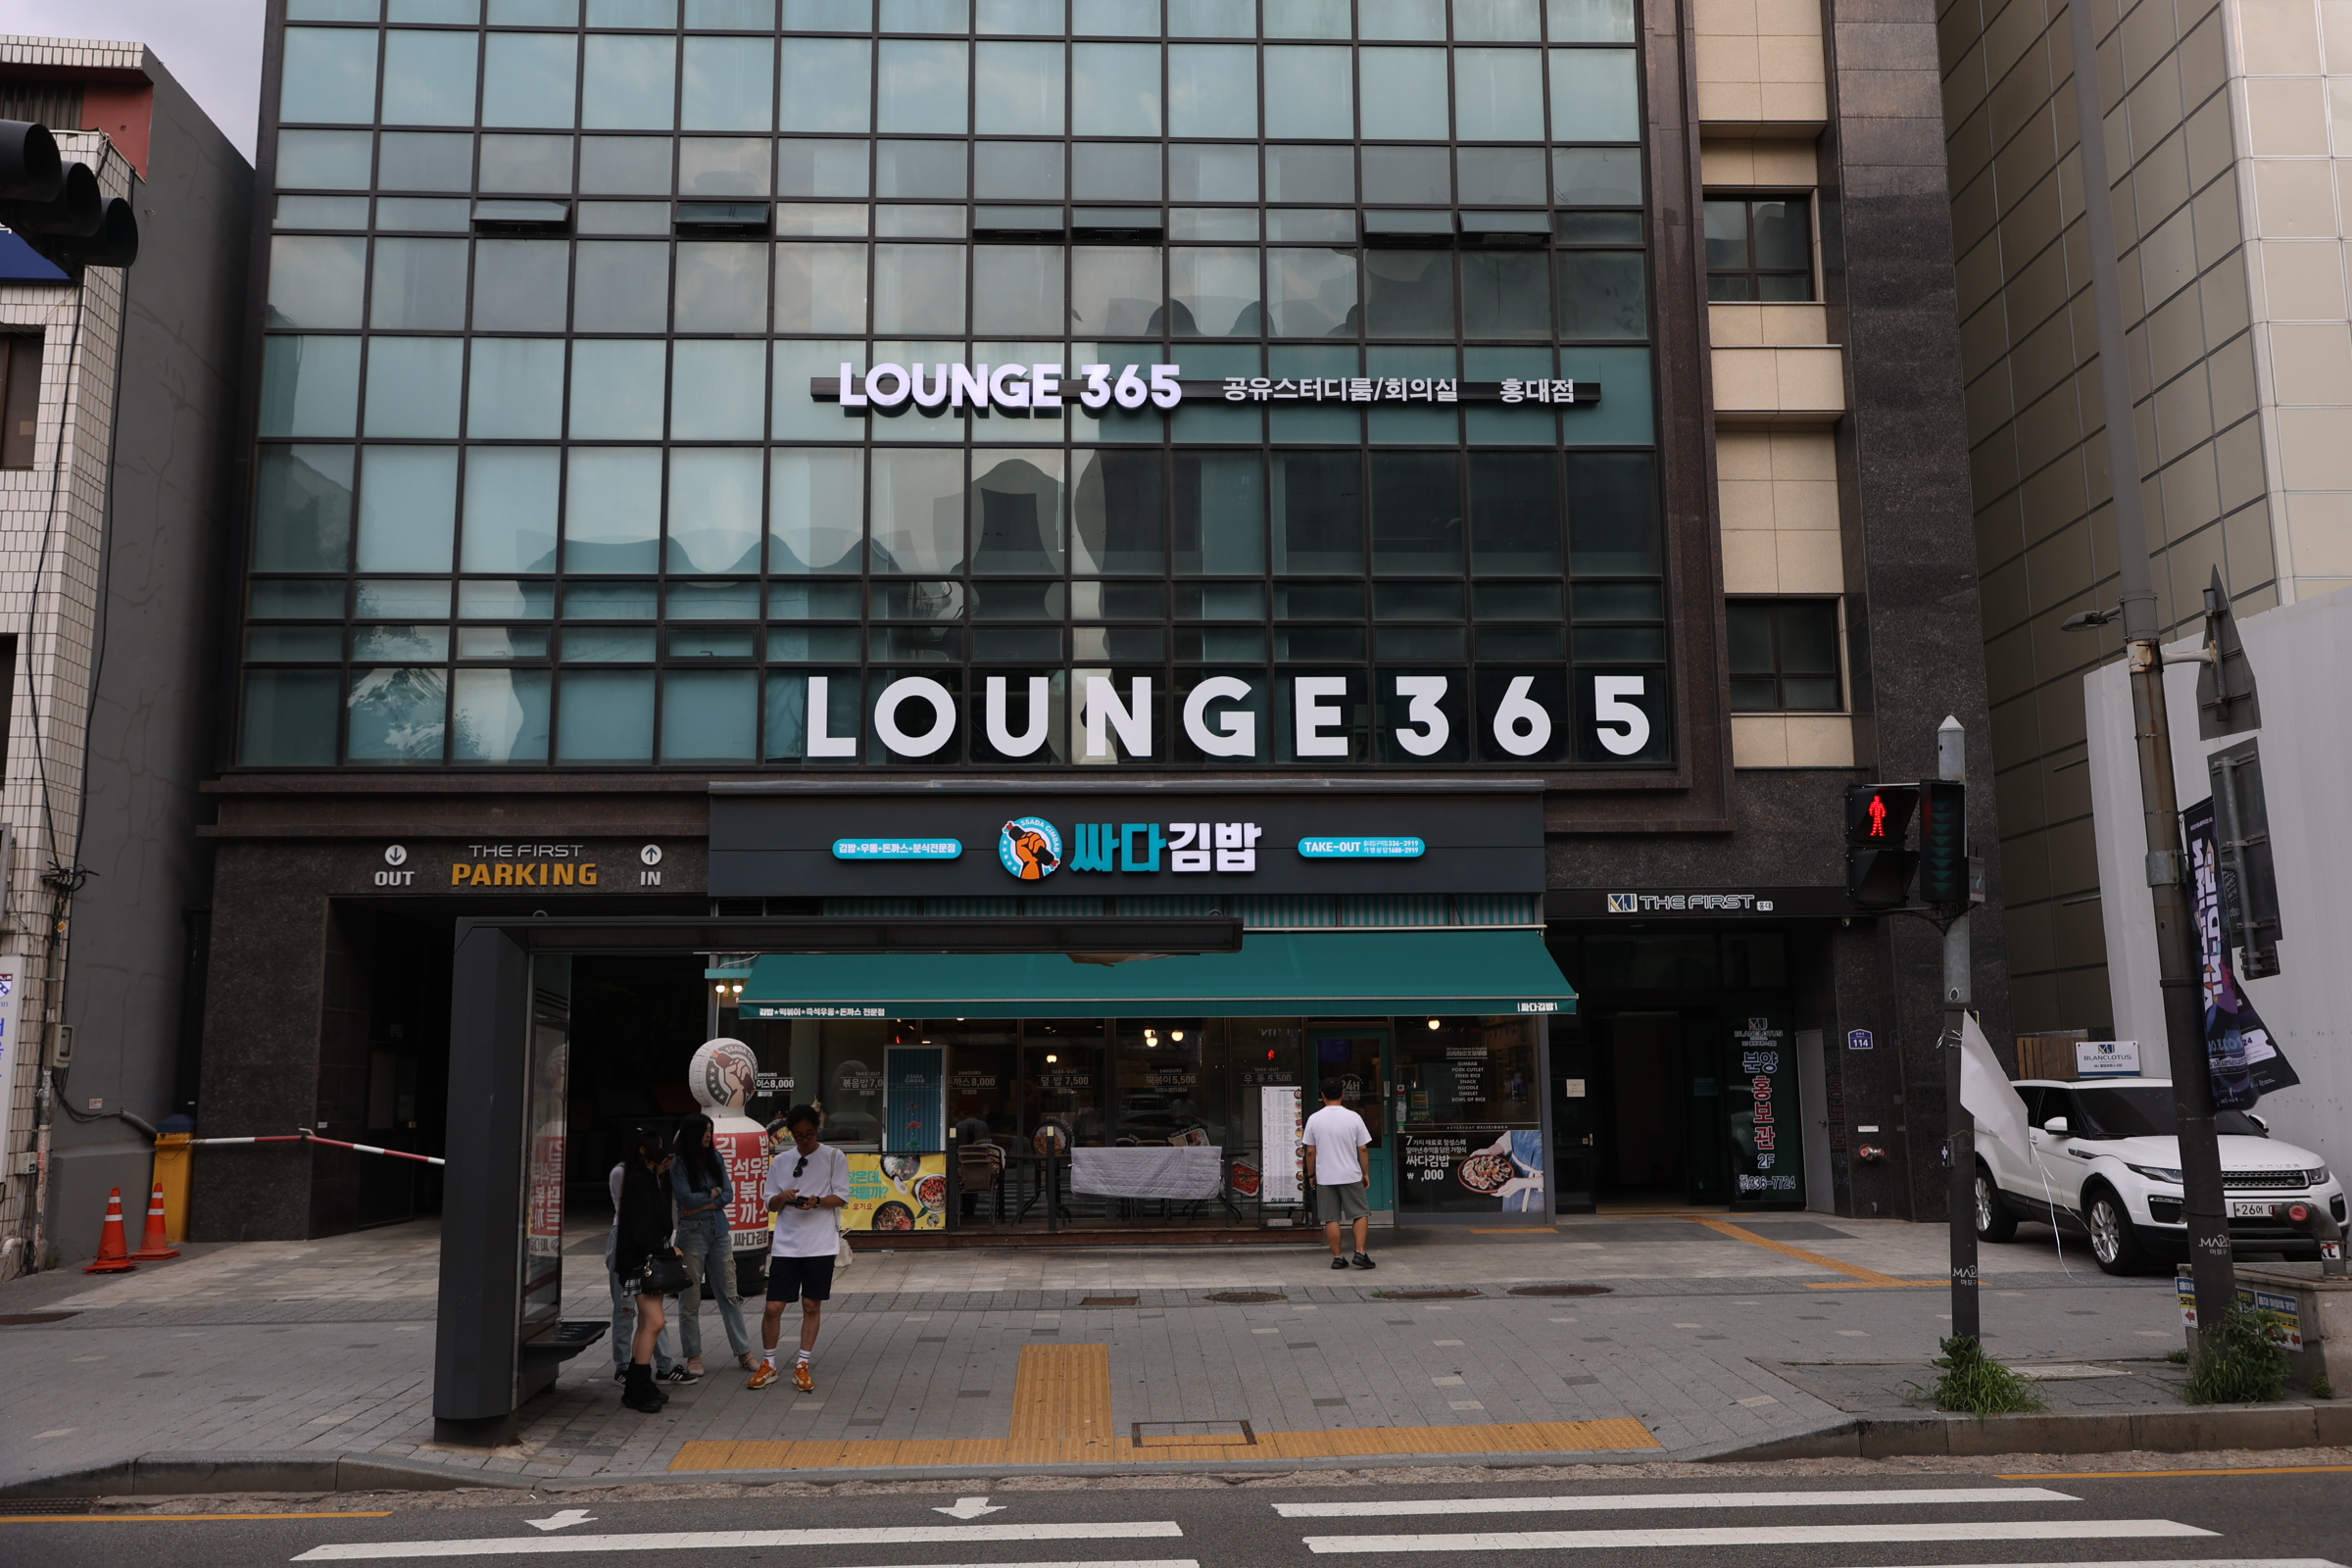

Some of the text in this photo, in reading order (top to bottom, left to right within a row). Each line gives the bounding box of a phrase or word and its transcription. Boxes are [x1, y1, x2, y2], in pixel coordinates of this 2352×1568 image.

[839, 362, 1182, 410] LOUNGE 365
[1222, 377, 1575, 403] 공유스터디룸/회의실 홍대점
[808, 675, 1650, 758] LOUNGE 365
[1020, 818, 1060, 853] SSADA GIMBAB
[468, 844, 584, 858] THE FIRST
[839, 843, 956, 854] 김밥 우동 돈까스 분식전문점
[1069, 823, 1262, 871] 싸다김밥
[1304, 842, 1361, 853] TAKE-OUT
[374, 871, 415, 886] OUT
[451, 863, 598, 886] PARKING
[640, 871, 662, 886] IN
[1640, 895, 1686, 909] THE
[1688, 895, 1755, 909] FIRST
[806, 1007, 834, 1016] 즉석우동
[862, 1007, 885, 1016] 전문점
[1521, 1002, 1555, 1012] 싸다김밥
[1853, 1039, 1869, 1048] 114
[1742, 1052, 1779, 1073] 분양
[770, 1079, 794, 1090] 8,000
[843, 1078, 868, 1089] 볶음밥
[971, 1078, 996, 1088] 8,000
[1064, 1077, 1089, 1087] 7,500
[1146, 1075, 1197, 1086] 떡볶이 5,500
[1405, 1154, 1450, 1168] 싸다김밥
[1757, 1153, 1775, 1169] 2F
[1749, 1176, 1796, 1190] 336-7724
